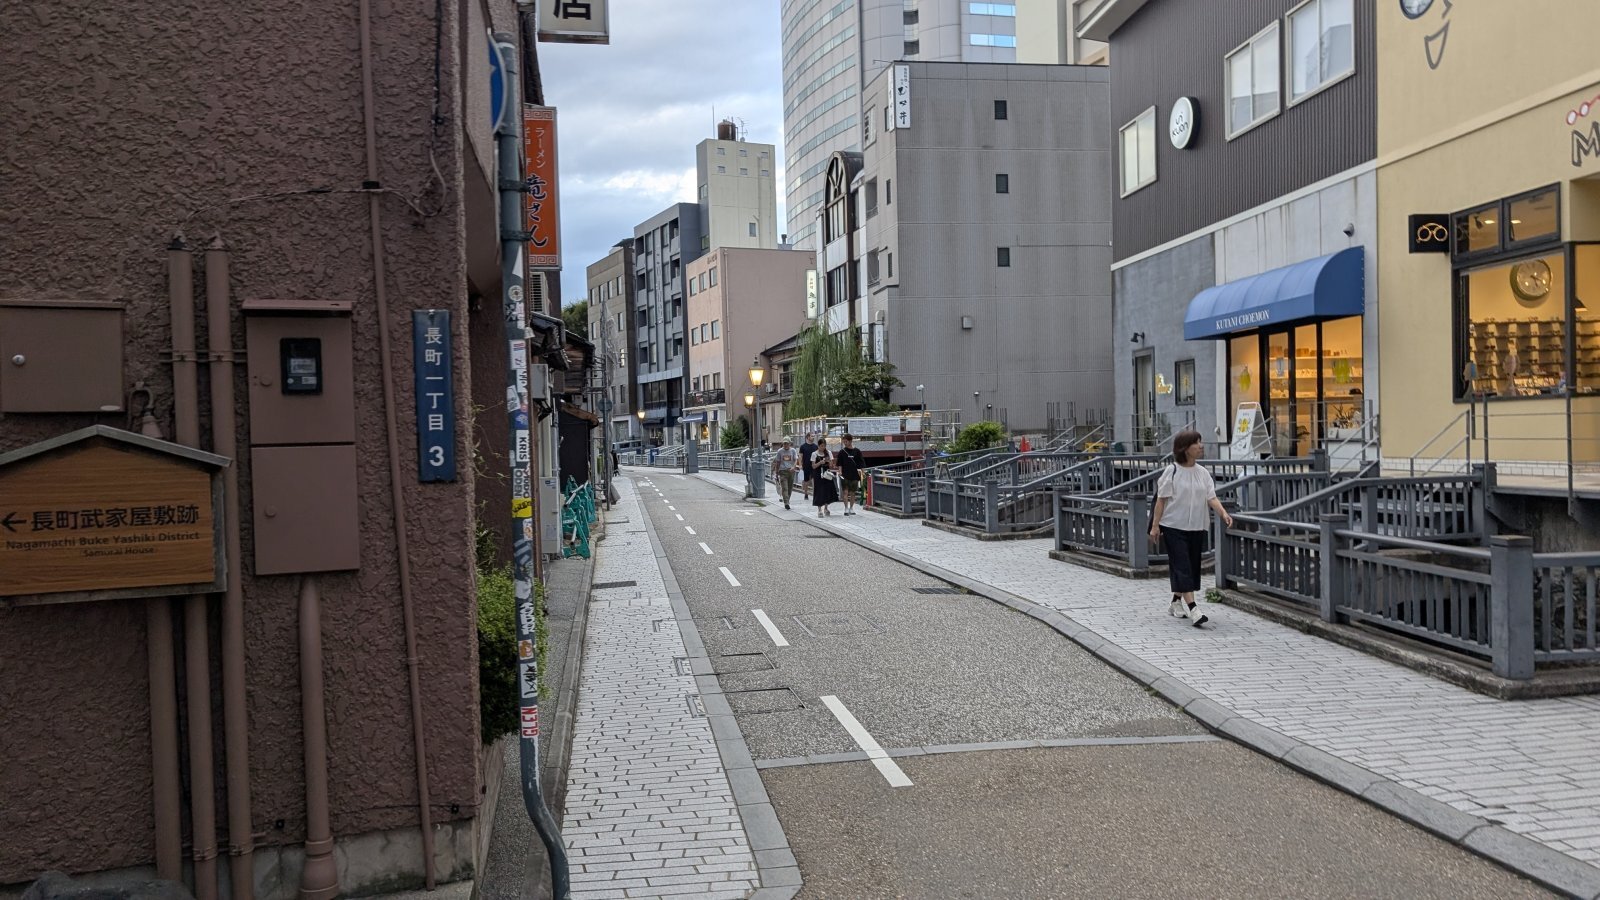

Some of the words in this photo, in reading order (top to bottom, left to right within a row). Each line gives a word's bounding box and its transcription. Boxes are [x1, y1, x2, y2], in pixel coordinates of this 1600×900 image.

[536, 128, 546, 168] ラーメン
[1215, 315, 1238, 330] KUTANI
[1238, 309, 1270, 326] CHOEMON
[424, 327, 445, 431] 長町一丁目
[428, 445, 445, 467] 3
[519, 436, 527, 460] KRIS
[514, 469, 523, 497] ODEN
[31, 506, 200, 531] 長町武家屋敷跡
[6, 538, 76, 551] Nagamachi
[79, 535, 109, 546] Buke
[113, 533, 156, 545] Yashiki
[158, 532, 200, 543] District
[522, 707, 538, 736] GLEN
